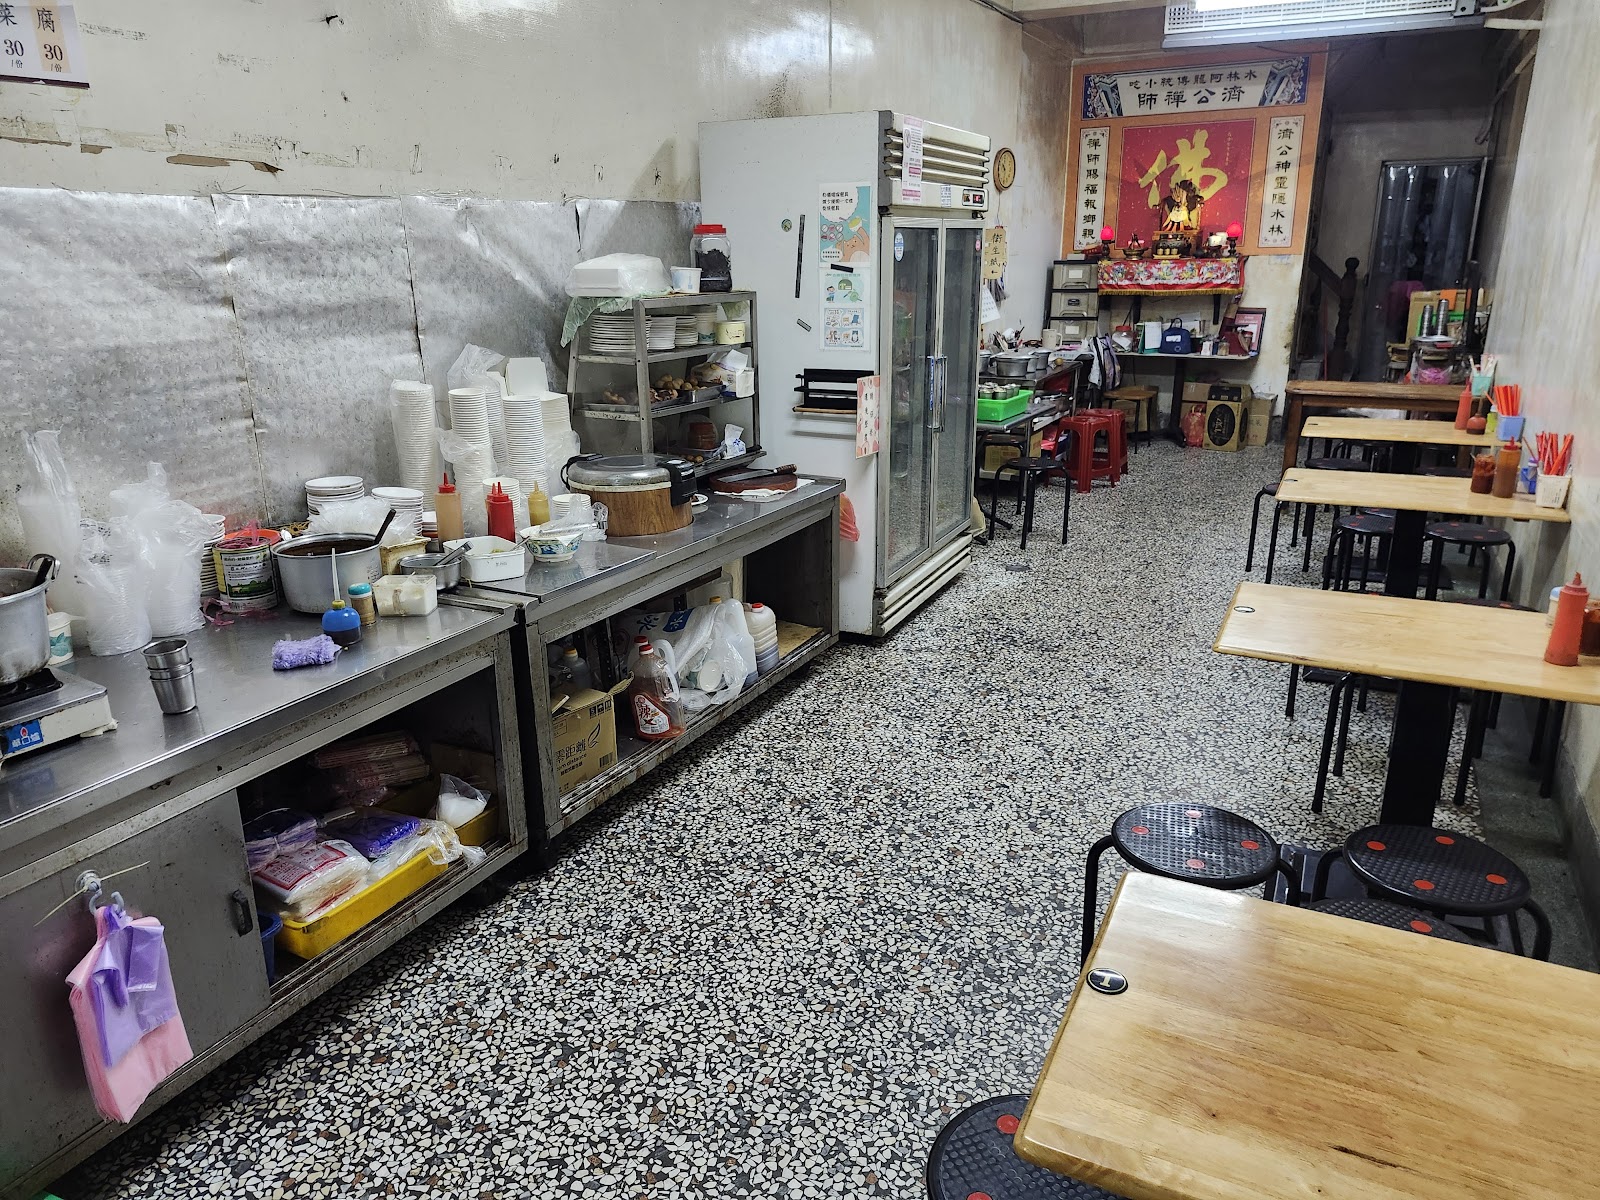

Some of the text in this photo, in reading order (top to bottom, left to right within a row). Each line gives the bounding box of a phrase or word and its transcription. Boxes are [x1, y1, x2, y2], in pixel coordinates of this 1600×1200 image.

[36, 8, 55, 33] 腐
[4, 39, 24, 57] 30
[44, 44, 63, 61] 30
[1081, 138, 1102, 240] 禪師賜福報鄉親
[1268, 128, 1295, 237] 濟公神靈隱水林
